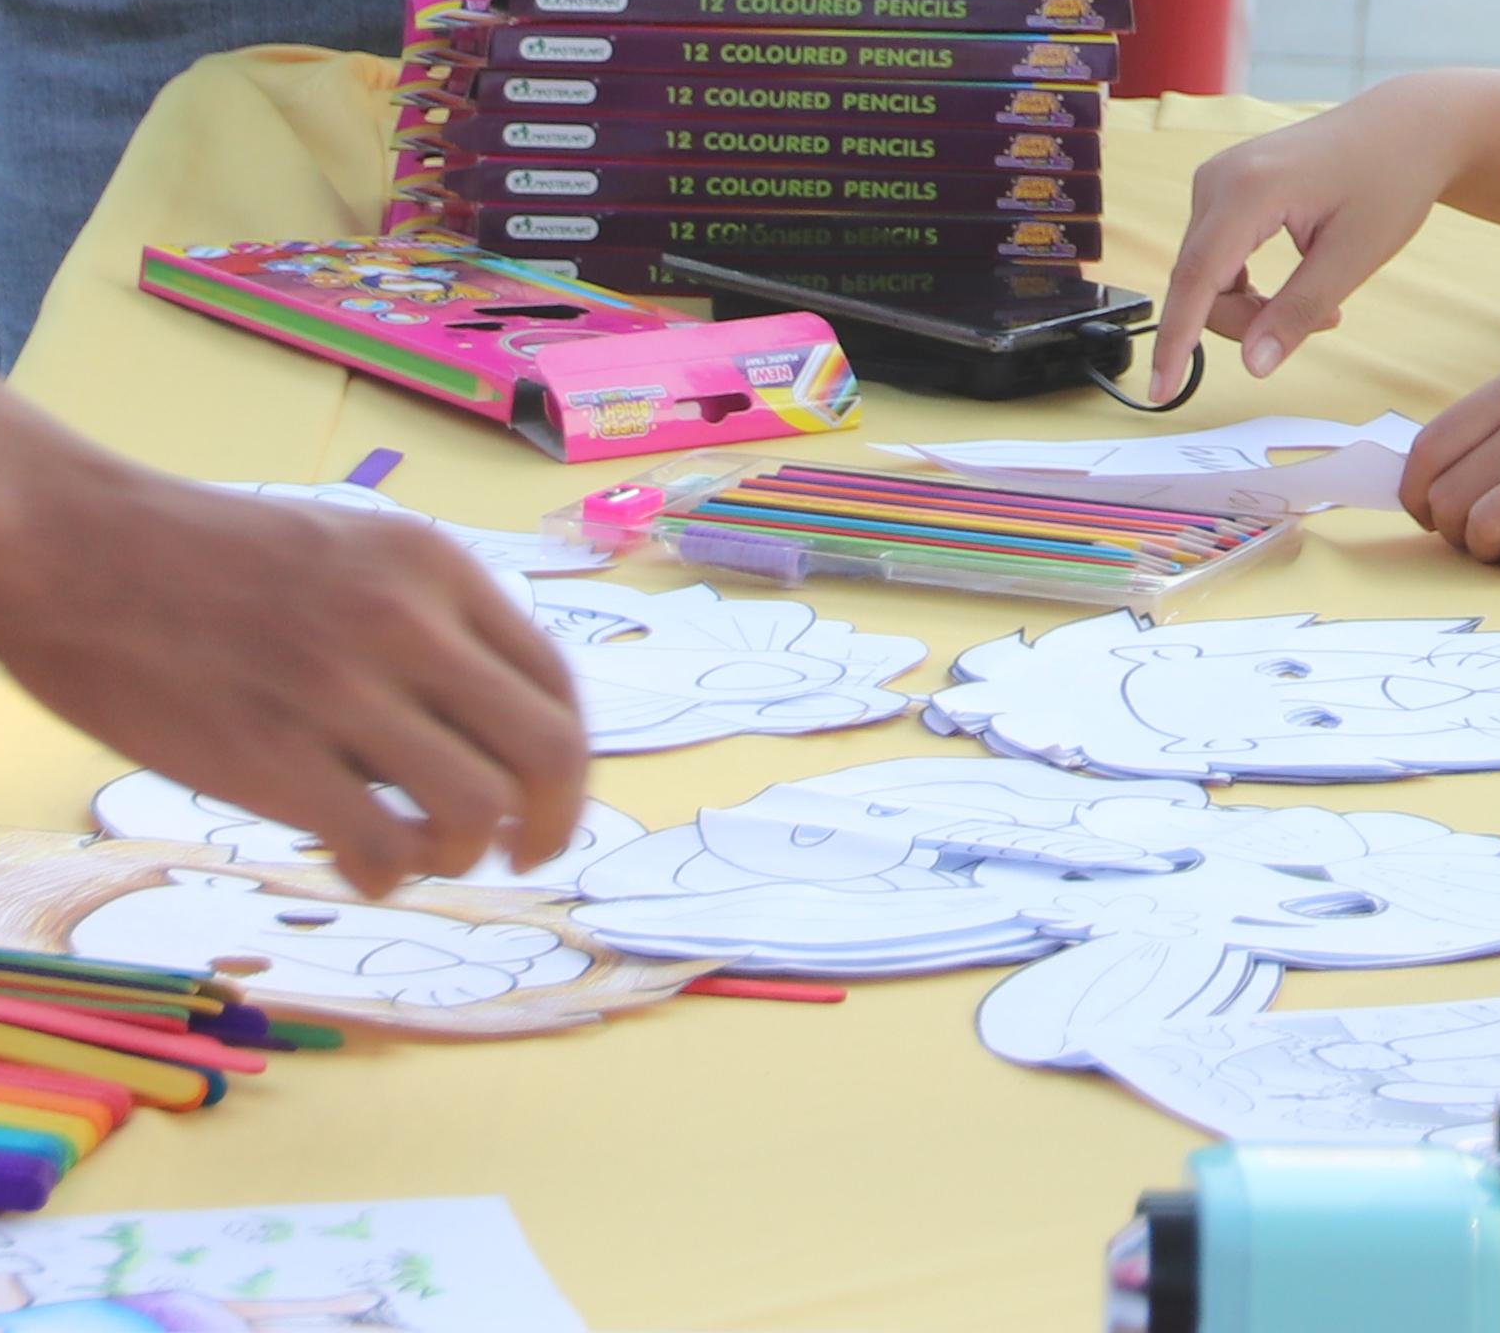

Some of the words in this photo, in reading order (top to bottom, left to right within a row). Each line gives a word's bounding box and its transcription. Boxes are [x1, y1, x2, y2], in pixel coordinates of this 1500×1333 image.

[682, 43, 709, 62] 12
[720, 43, 848, 66] COLOURED
[859, 46, 953, 68] PENCILS
[666, 86, 693, 105] 12
[704, 87, 831, 110] COLOURED
[842, 90, 937, 114] PENCILS
[665, 131, 692, 149] 12
[703, 132, 830, 155] COLOURED
[841, 135, 936, 158] PENCILS
[668, 176, 694, 195] 12
[706, 177, 833, 199] COLOURED
[844, 180, 938, 201] PENCILS
[669, 222, 695, 240] 12
[750, 365, 793, 384] NEW!
[601, 417, 647, 437] SUPER
